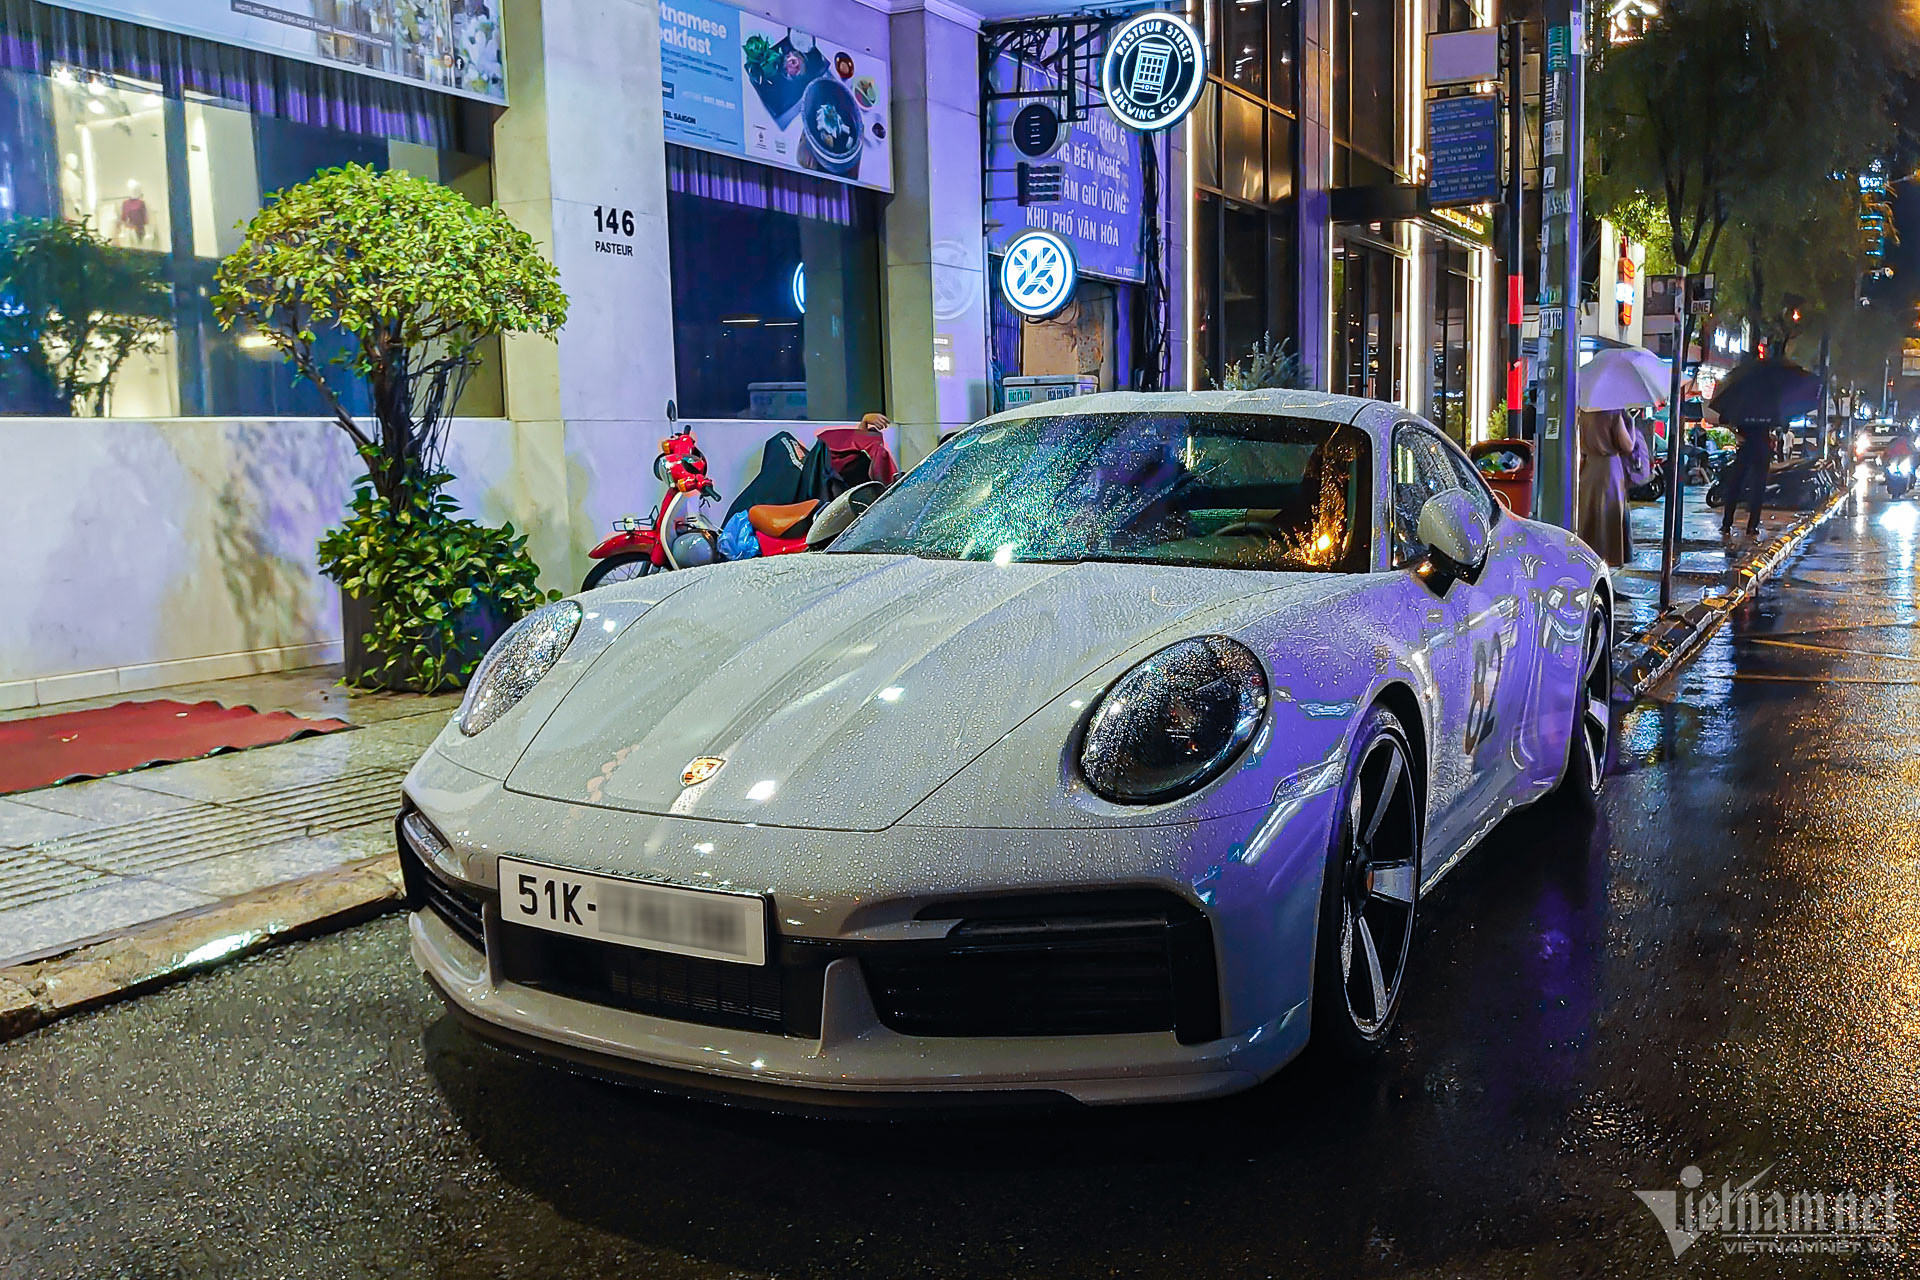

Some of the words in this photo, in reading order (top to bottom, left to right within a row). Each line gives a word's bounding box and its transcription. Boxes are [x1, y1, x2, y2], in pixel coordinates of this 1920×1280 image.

[660, 1, 728, 39] tnamese
[1115, 21, 1163, 56] PASTEUR
[1165, 24, 1194, 63] STREET
[1111, 87, 1156, 120] BREWING
[1119, 127, 1127, 146] 6
[1073, 142, 1094, 171] BẾN
[1097, 153, 1121, 180] NGHÉ
[593, 205, 635, 237] 146
[1026, 205, 1048, 230] KHU
[1052, 209, 1074, 236] PHỐ
[1077, 215, 1097, 241] VĂN
[1100, 219, 1119, 247] HÓA
[594, 240, 634, 257] PASTEUR
[1464, 632, 1502, 756] 82
